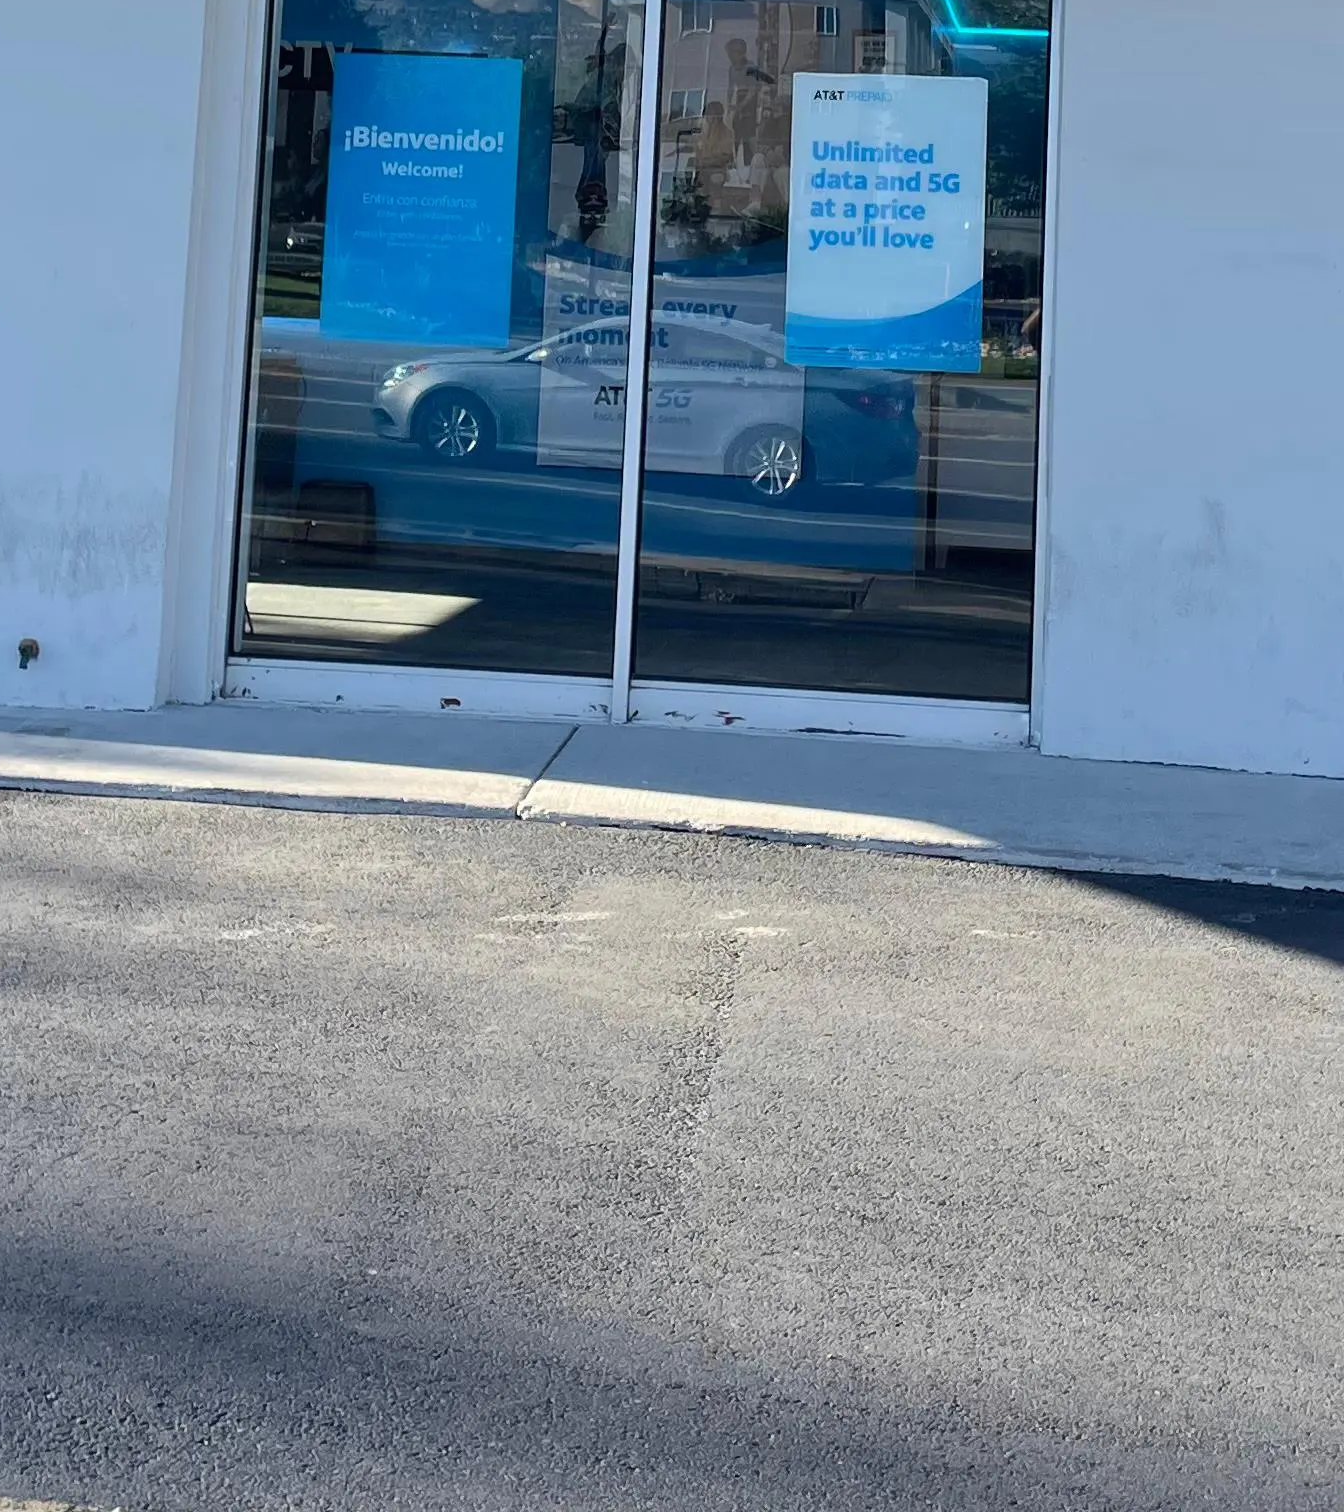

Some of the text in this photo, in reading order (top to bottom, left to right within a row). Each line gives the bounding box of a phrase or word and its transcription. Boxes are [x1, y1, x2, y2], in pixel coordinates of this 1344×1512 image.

[813, 90, 893, 102] AT&T PREPAID
[344, 125, 504, 153] ¡Bienvenido!
[811, 140, 934, 165] Unlimited
[382, 161, 464, 179] Welcome!
[810, 168, 961, 194] data and 5G
[421, 194, 477, 209] confianza
[809, 198, 926, 225] at a price
[808, 225, 934, 251] you'll love
[559, 294, 738, 327] Strea every
[655, 389, 693, 409] 5G
